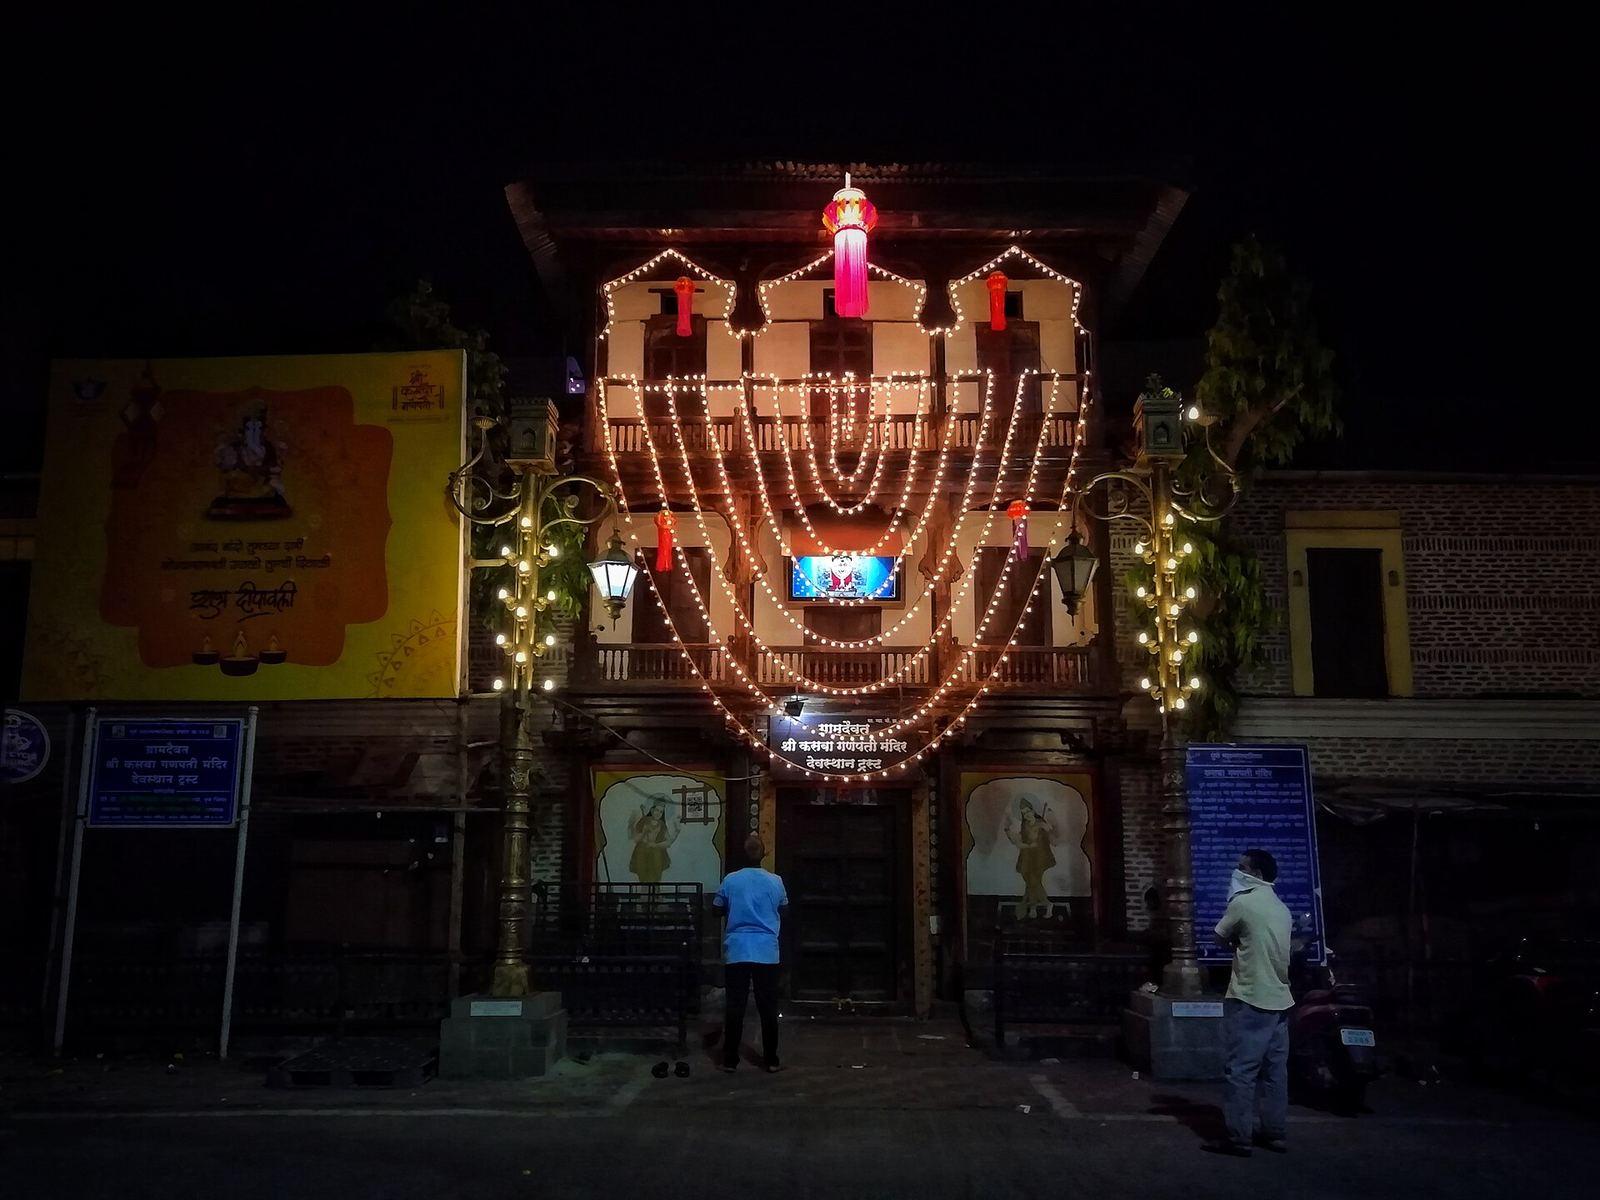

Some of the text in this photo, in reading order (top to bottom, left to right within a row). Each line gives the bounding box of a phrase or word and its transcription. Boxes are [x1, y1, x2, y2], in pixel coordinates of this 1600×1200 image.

[818, 720, 870, 735] ग्रामदैवत
[781, 738, 907, 752] श्री कसबा गणपती मंदिर
[123, 759, 157, 769] कसबा
[160, 757, 198, 769] गणपती
[202, 756, 228, 771] मंदिर
[806, 756, 882, 772] देवस्थान ट्रस्ट
[131, 771, 174, 784] देवस्थान
